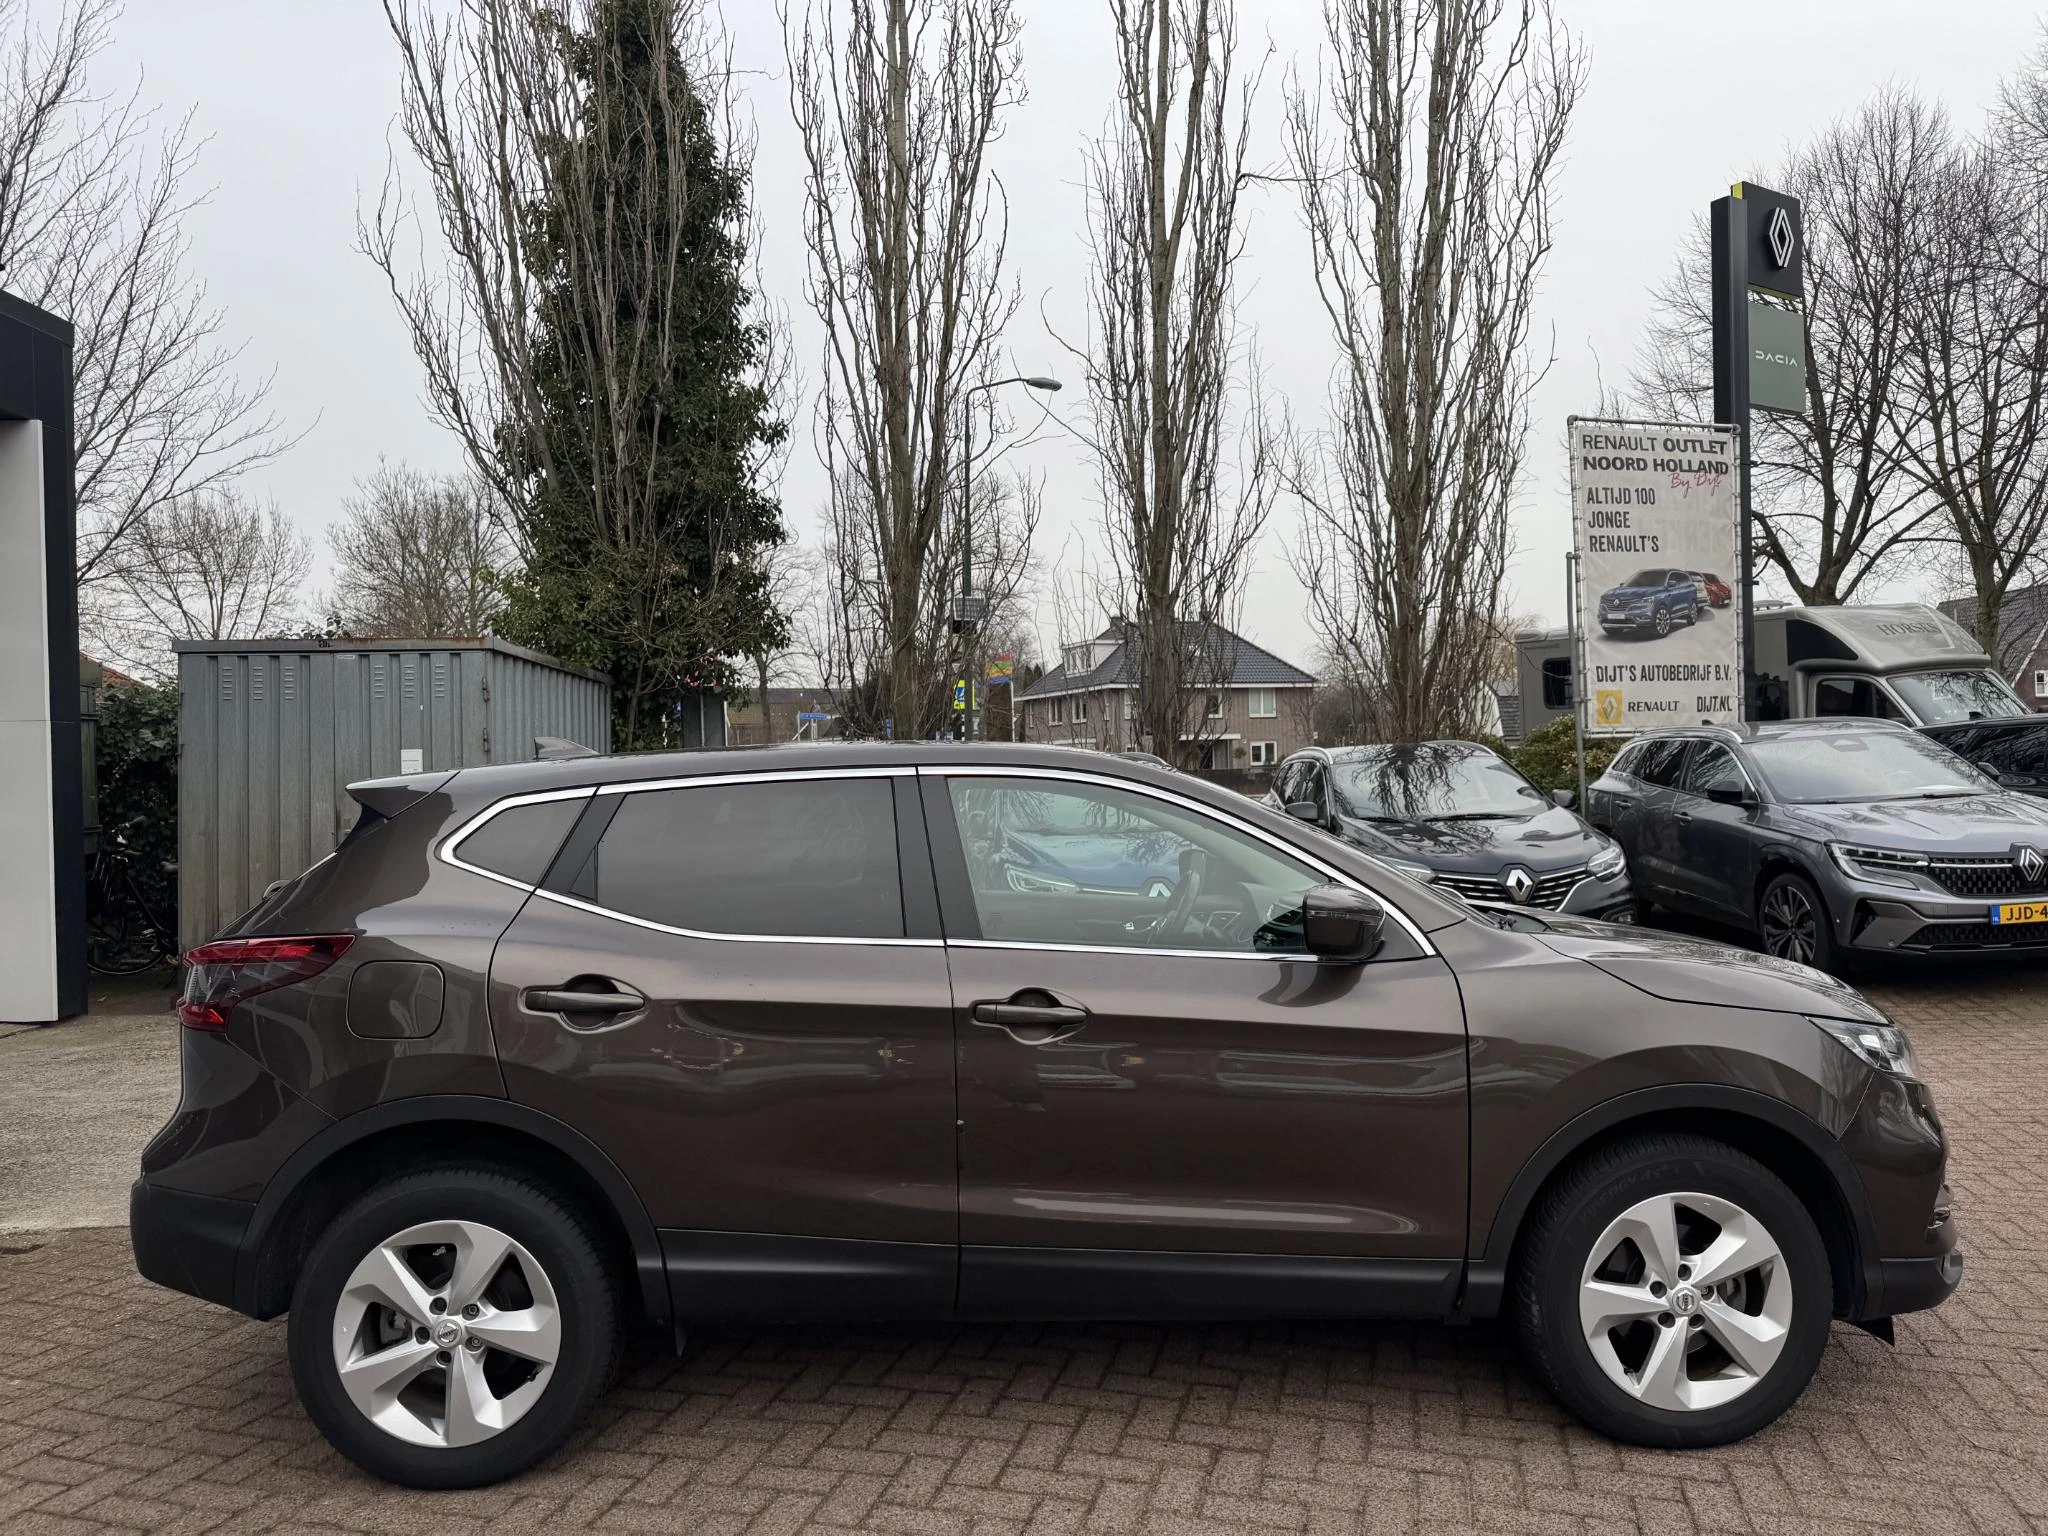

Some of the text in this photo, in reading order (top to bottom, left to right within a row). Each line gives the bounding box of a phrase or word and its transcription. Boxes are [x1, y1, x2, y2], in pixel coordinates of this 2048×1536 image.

[1755, 350, 1798, 367] DACIA
[1582, 434, 1727, 455] RENAULT OUTLET
[1583, 456, 1728, 475] NOORD HOLLAND
[1668, 472, 1692, 499] By
[1587, 487, 1656, 505] ALTIJD 100
[1588, 511, 1631, 529] JONGE
[1589, 535, 1659, 552] RENAULT'S
[1876, 622, 1942, 635] HORSES
[1596, 664, 1732, 683] DIJT'S AUTOBEDRIJF B.V.
[1628, 700, 1680, 712] RENAULT
[1696, 695, 1733, 713] DIJT.NL
